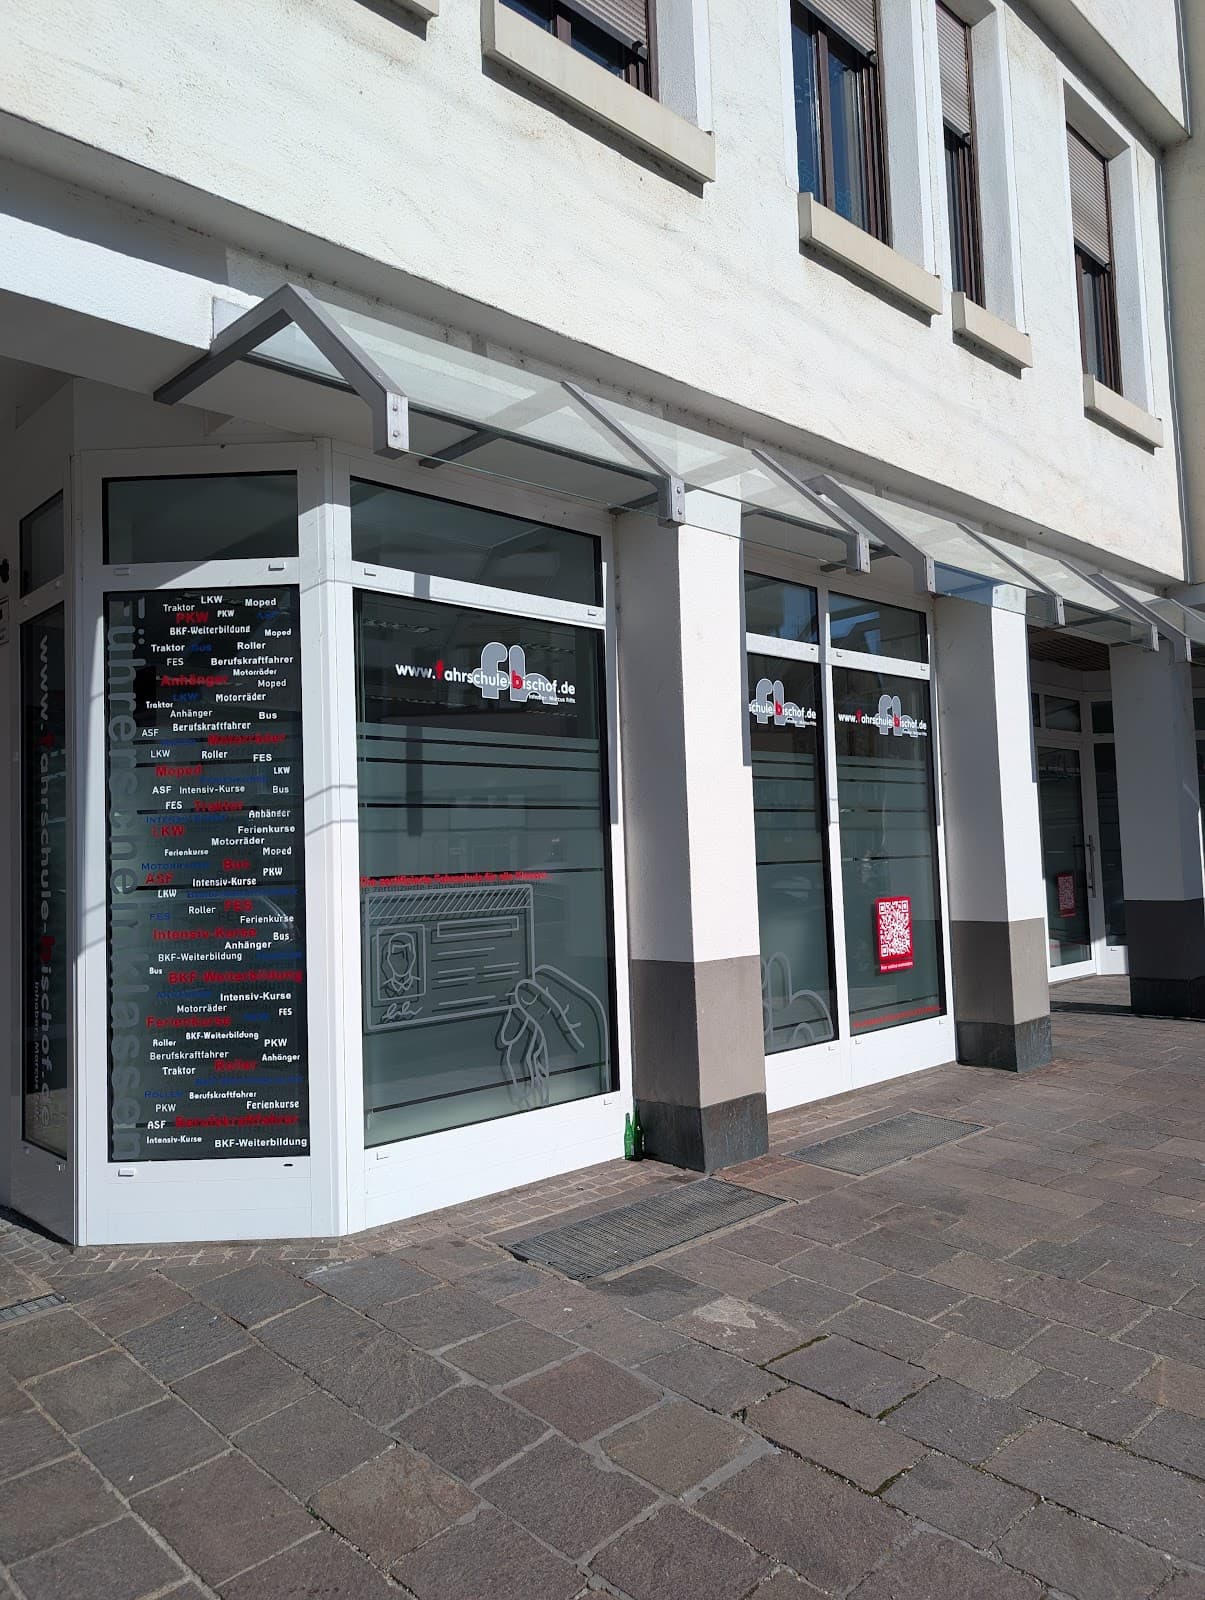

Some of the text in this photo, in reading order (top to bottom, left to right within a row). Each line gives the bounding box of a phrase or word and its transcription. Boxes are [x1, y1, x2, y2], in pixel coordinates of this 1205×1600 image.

[201, 596, 223, 604] LKW
[245, 598, 277, 608] Moped
[163, 604, 195, 612] Traktor
[176, 612, 209, 624] PKW
[170, 625, 250, 635] BKF-Weiterbildung
[265, 628, 291, 637] Moped
[151, 644, 185, 652] Traktor
[237, 642, 266, 650] Roller
[167, 658, 184, 666] FES
[211, 657, 293, 666] Berufskraftfahrer
[258, 679, 286, 688] Moped
[216, 693, 266, 702] Motorräder
[170, 709, 212, 718] Anhänger
[258, 712, 277, 720] Bus
[173, 722, 251, 732] Berufskraftfahrer
[151, 750, 170, 758] LKW
[202, 750, 228, 759] Roller
[156, 765, 202, 777] Moped
[152, 786, 171, 794] ASF
[180, 785, 245, 794] Intensiv-Kurse
[249, 810, 290, 819] Anhänger
[238, 825, 295, 834] Ferienkurse
[212, 837, 264, 845] Motorräder
[263, 847, 291, 856] Moped
[263, 868, 283, 876] PKW
[37, 634, 56, 1128] www.fahrschule-bischof.de
[193, 878, 256, 887] Intensiv-Kurse
[158, 890, 176, 898] LKW
[188, 906, 216, 914] Roller
[240, 915, 294, 923] Ferienkurse
[273, 932, 290, 940] Bus
[225, 942, 271, 950] Anhänger
[158, 953, 242, 962] BKF-Weiterbildung
[220, 992, 291, 1002] Intensiv-Kurse
[177, 1004, 227, 1013] Motorräder
[278, 1008, 292, 1016] FES
[186, 1032, 259, 1040] BKF-Weiterbildung
[153, 1039, 176, 1047] Roller
[264, 1039, 287, 1047] PKW
[150, 1051, 229, 1060] Berufskraftfahrer
[262, 1054, 300, 1063] Anhänger
[162, 1067, 196, 1075] Traktor
[189, 1091, 256, 1099] Berufskraftfahrer
[155, 1104, 176, 1112] PKW
[247, 1101, 299, 1109] Ferienkurse
[148, 1121, 167, 1129] ASF
[147, 1135, 202, 1144] Intensiv-Kurse
[215, 1138, 307, 1148] BKF-Weiterbildung
